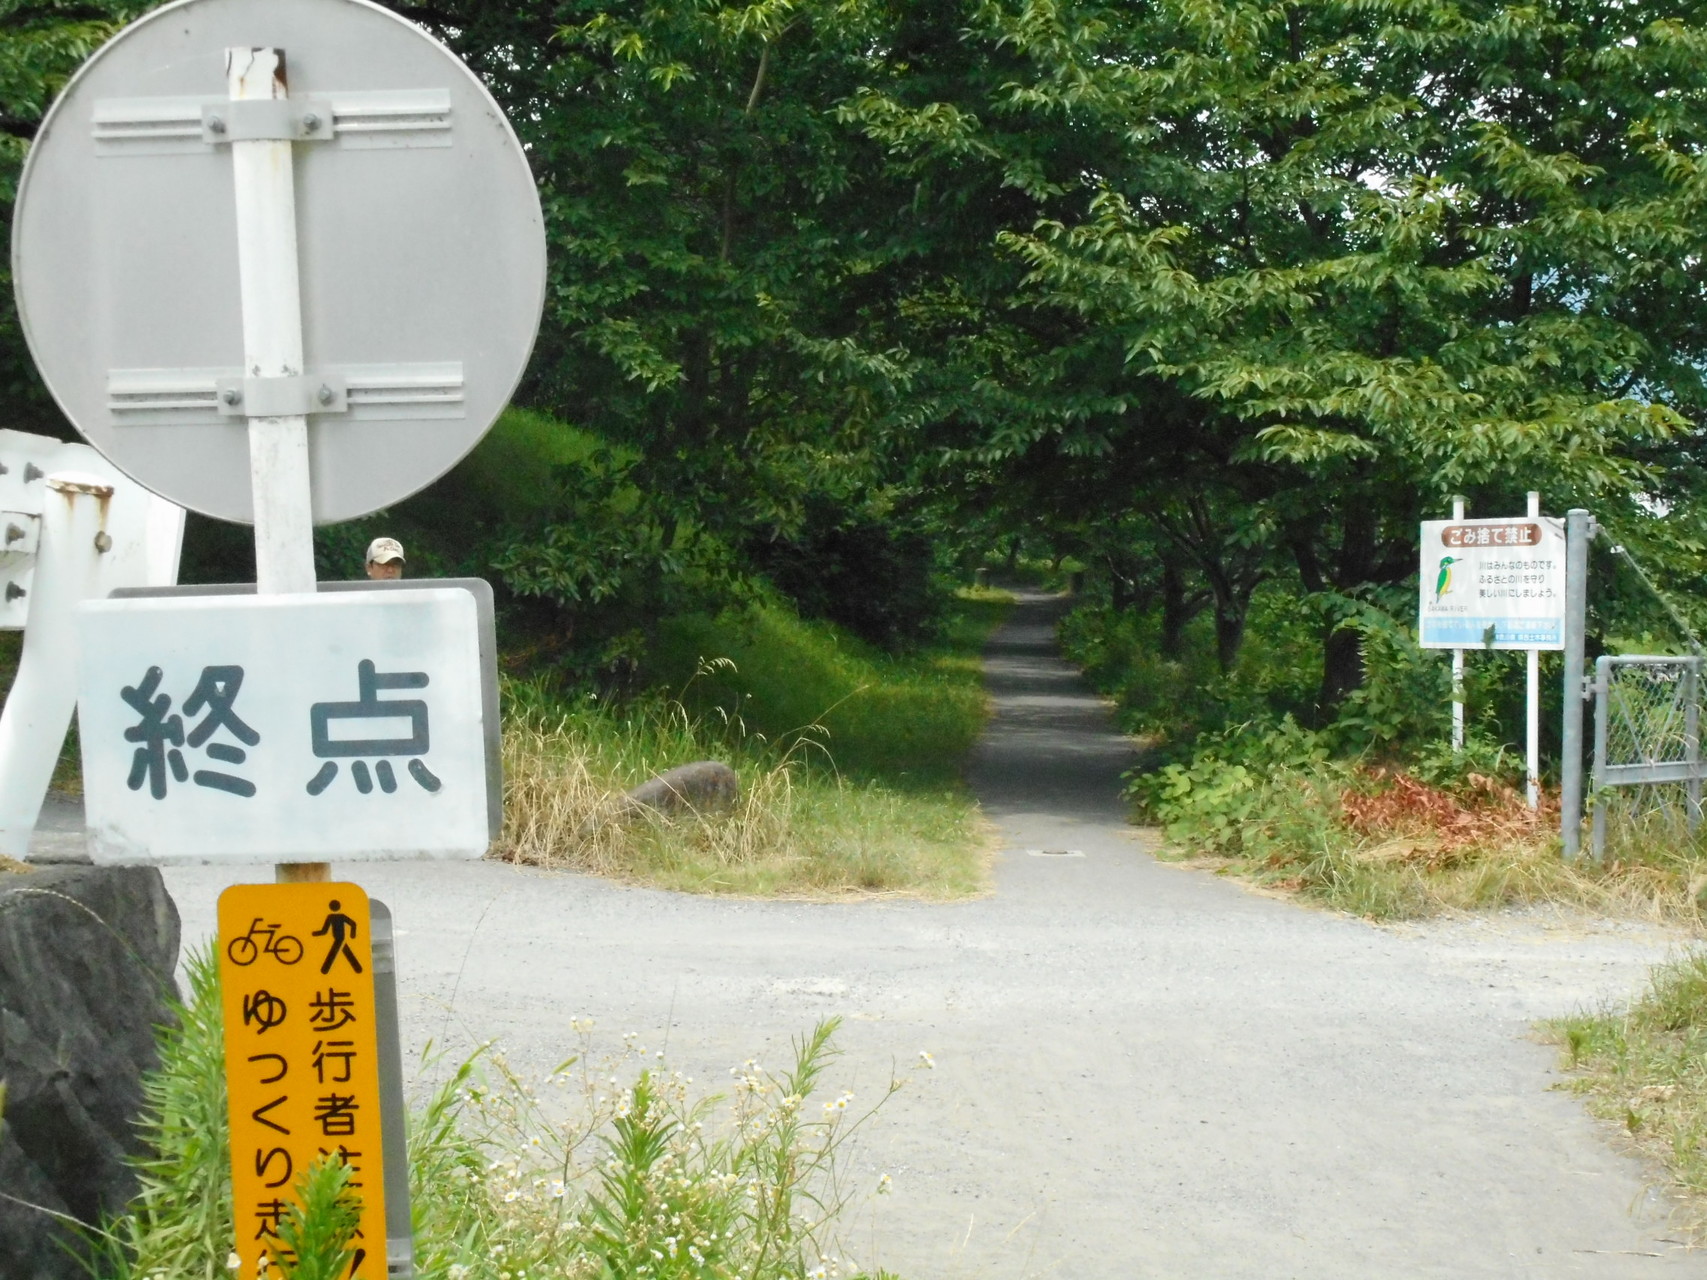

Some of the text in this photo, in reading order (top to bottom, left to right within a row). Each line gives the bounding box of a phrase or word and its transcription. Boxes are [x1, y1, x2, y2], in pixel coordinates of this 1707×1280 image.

[1450, 526, 1532, 545] ごみ捨て禁止
[120, 658, 442, 800] 終点
